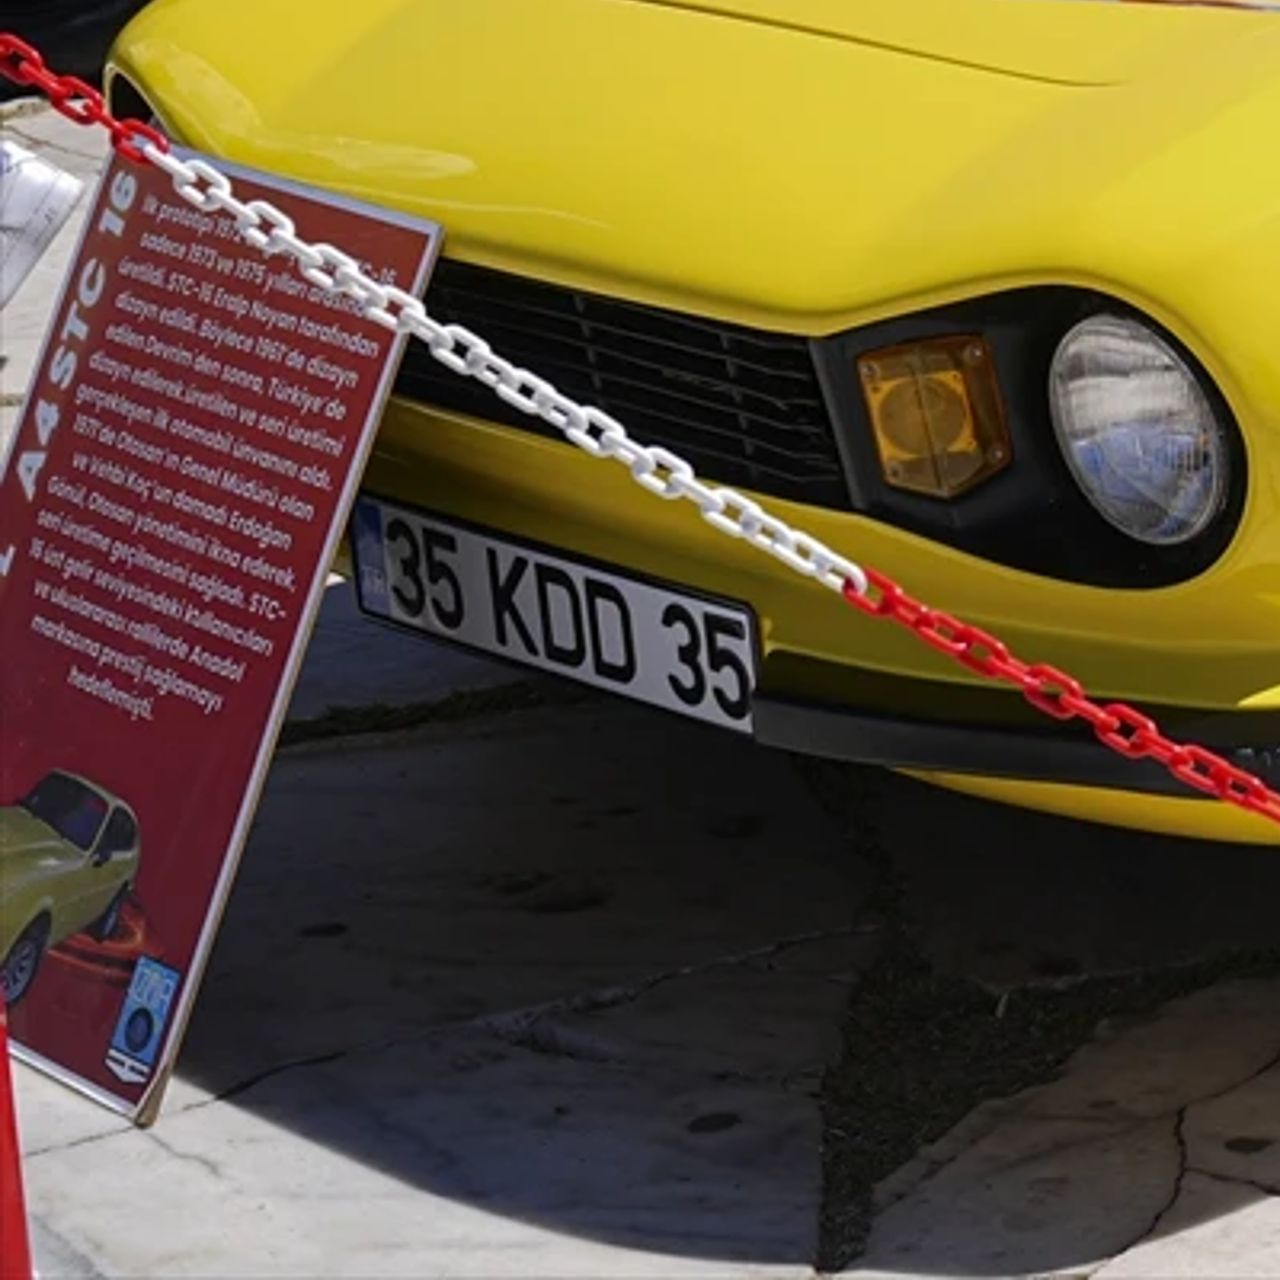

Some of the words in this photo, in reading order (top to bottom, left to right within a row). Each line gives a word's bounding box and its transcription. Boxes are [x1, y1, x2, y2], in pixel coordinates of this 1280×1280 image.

[17, 397, 61, 503] A4
[48, 255, 108, 392] STC
[98, 169, 139, 238] 16
[386, 519, 464, 630] 35
[487, 547, 636, 685] KDD
[661, 603, 752, 720] 35
